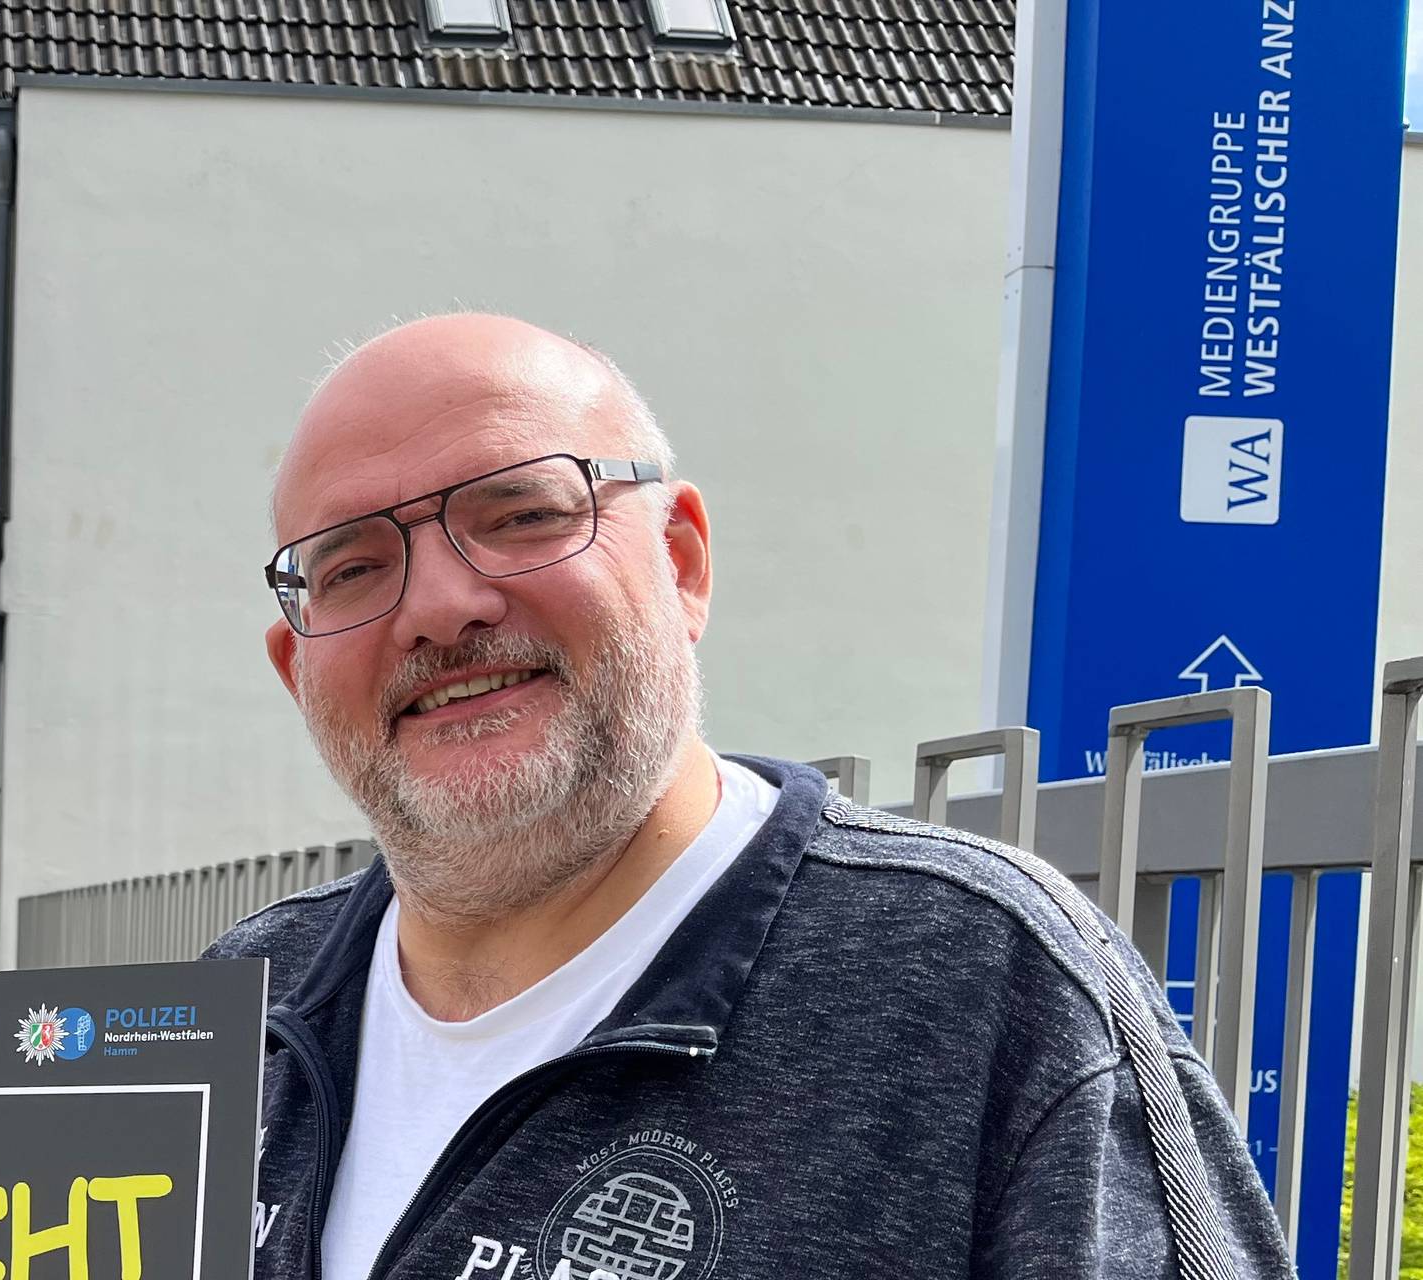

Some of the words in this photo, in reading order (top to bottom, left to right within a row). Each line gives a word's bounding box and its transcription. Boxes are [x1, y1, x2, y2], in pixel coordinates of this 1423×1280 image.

[1198, 111, 1245, 397] MEDIENGRUPPE
[1243, 89, 1290, 397] WESTFÄLISCHER
[1227, 428, 1272, 513] WA
[104, 1006, 196, 1028] POLIZEI
[104, 1030, 214, 1043] Nordrhein-Westfalen
[104, 1046, 138, 1057] Hamm
[576, 1140, 618, 1174] MOST
[628, 1129, 698, 1155] MODERN
[699, 1151, 739, 1209] PLACES
